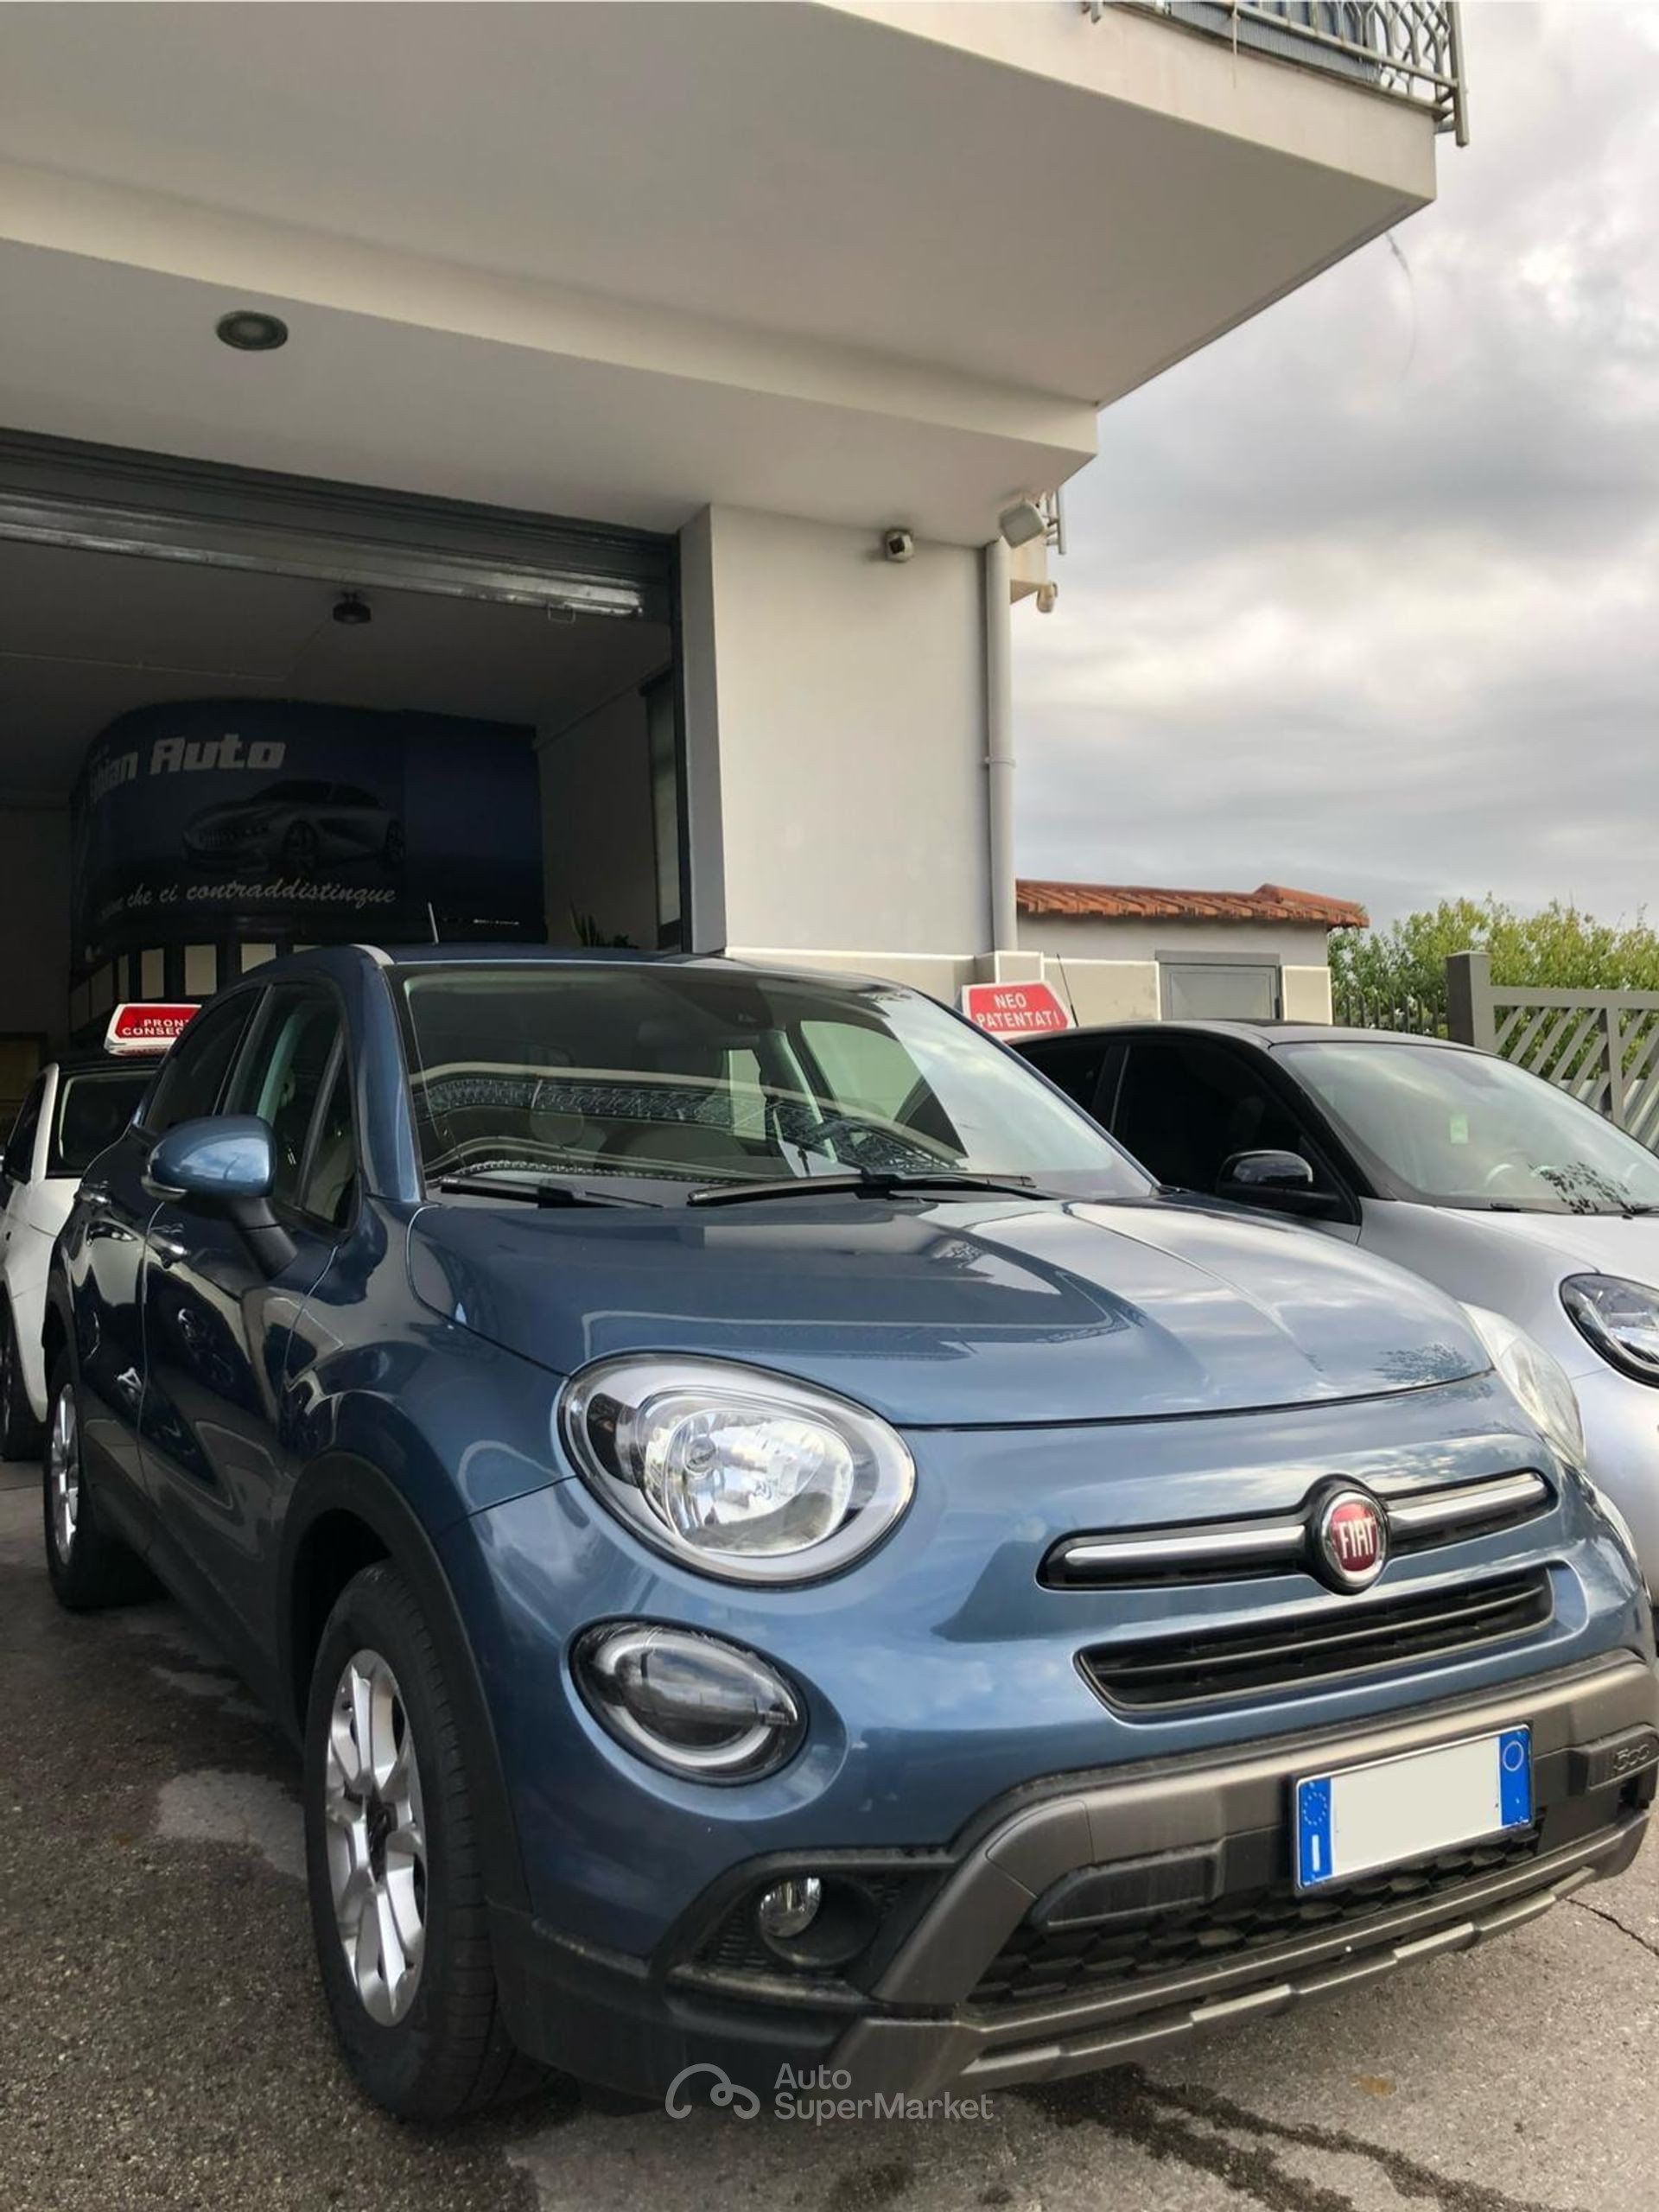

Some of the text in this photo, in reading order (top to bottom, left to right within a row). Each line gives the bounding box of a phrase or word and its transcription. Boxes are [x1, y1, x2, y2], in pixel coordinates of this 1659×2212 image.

[150, 734, 286, 774] Auto
[128, 880, 397, 908] che ci contraddistingue
[994, 992, 1027, 1008] NEO
[976, 1010, 1060, 1027] PATENTATI
[1338, 1516, 1375, 1559] FIAT
[1612, 1743, 1649, 1770] 500
